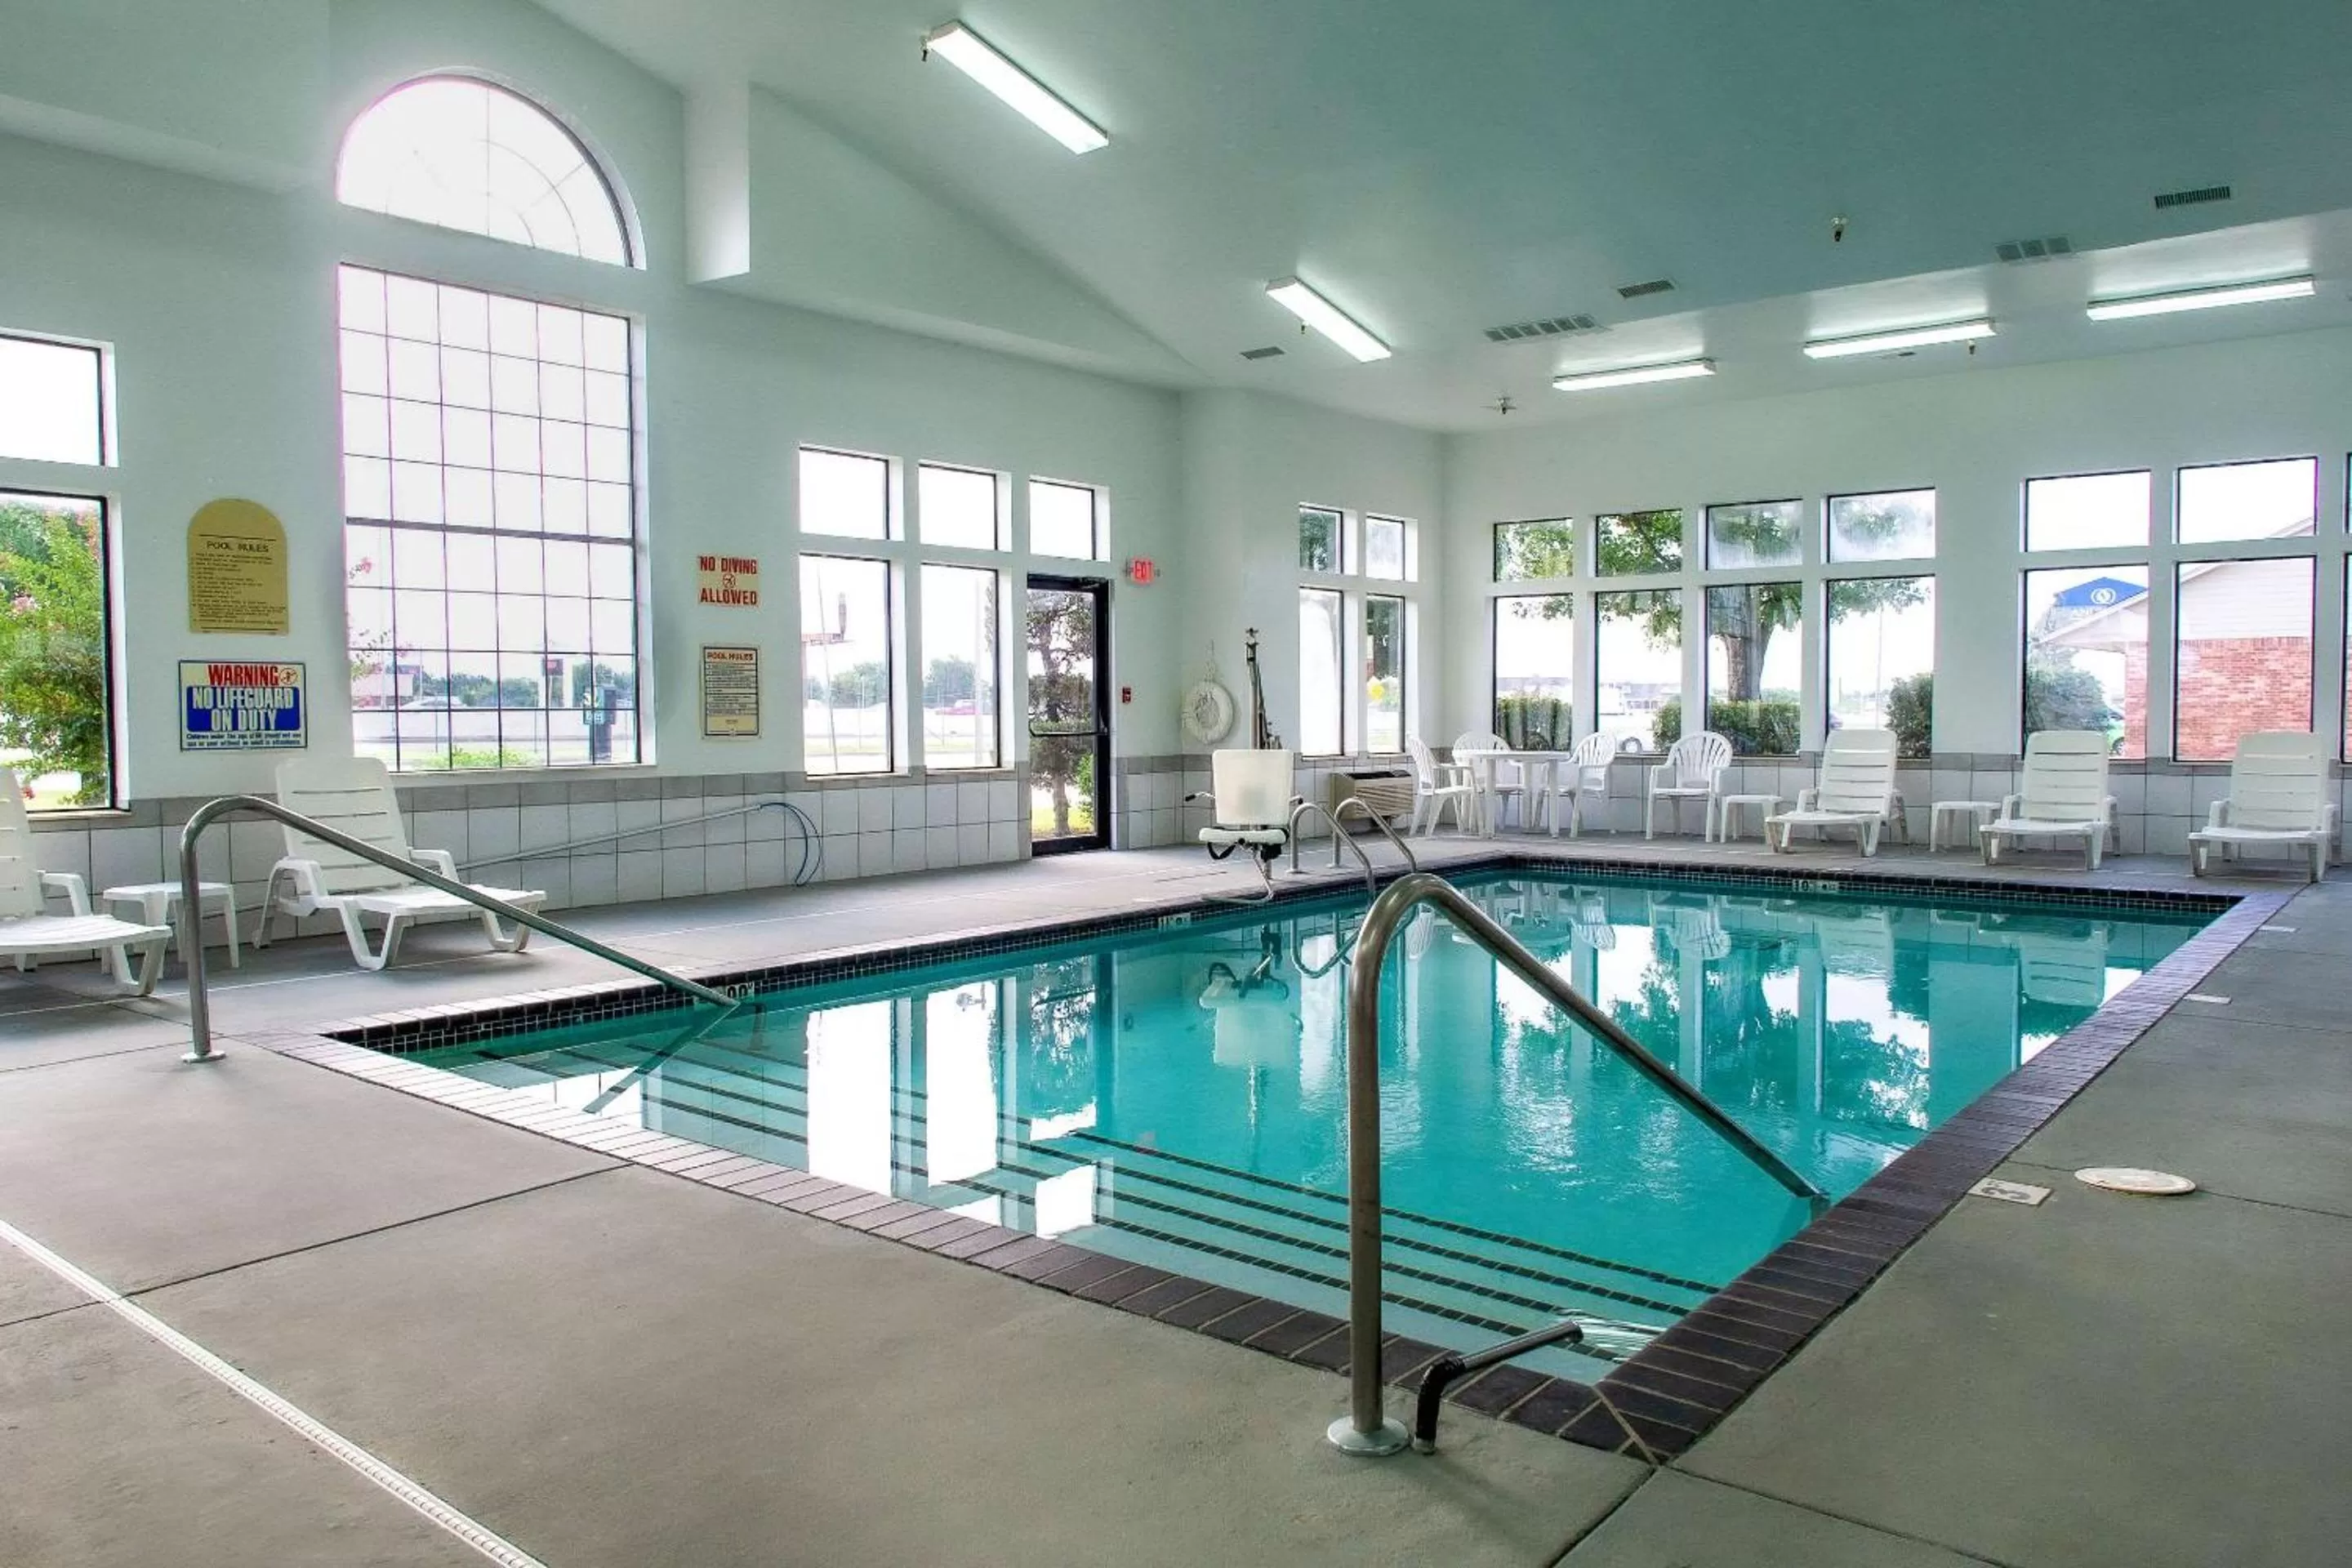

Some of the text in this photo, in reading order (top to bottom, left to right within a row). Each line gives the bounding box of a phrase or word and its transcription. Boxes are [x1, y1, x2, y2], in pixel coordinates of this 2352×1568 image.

[207, 541, 233, 550] POOL
[700, 556, 757, 574] NO DIVING
[701, 587, 757, 605] ALLOWED
[207, 664, 279, 687] WARNING
[192, 687, 294, 709] NO LIFEGUARD
[211, 709, 277, 732] ON DUTY
